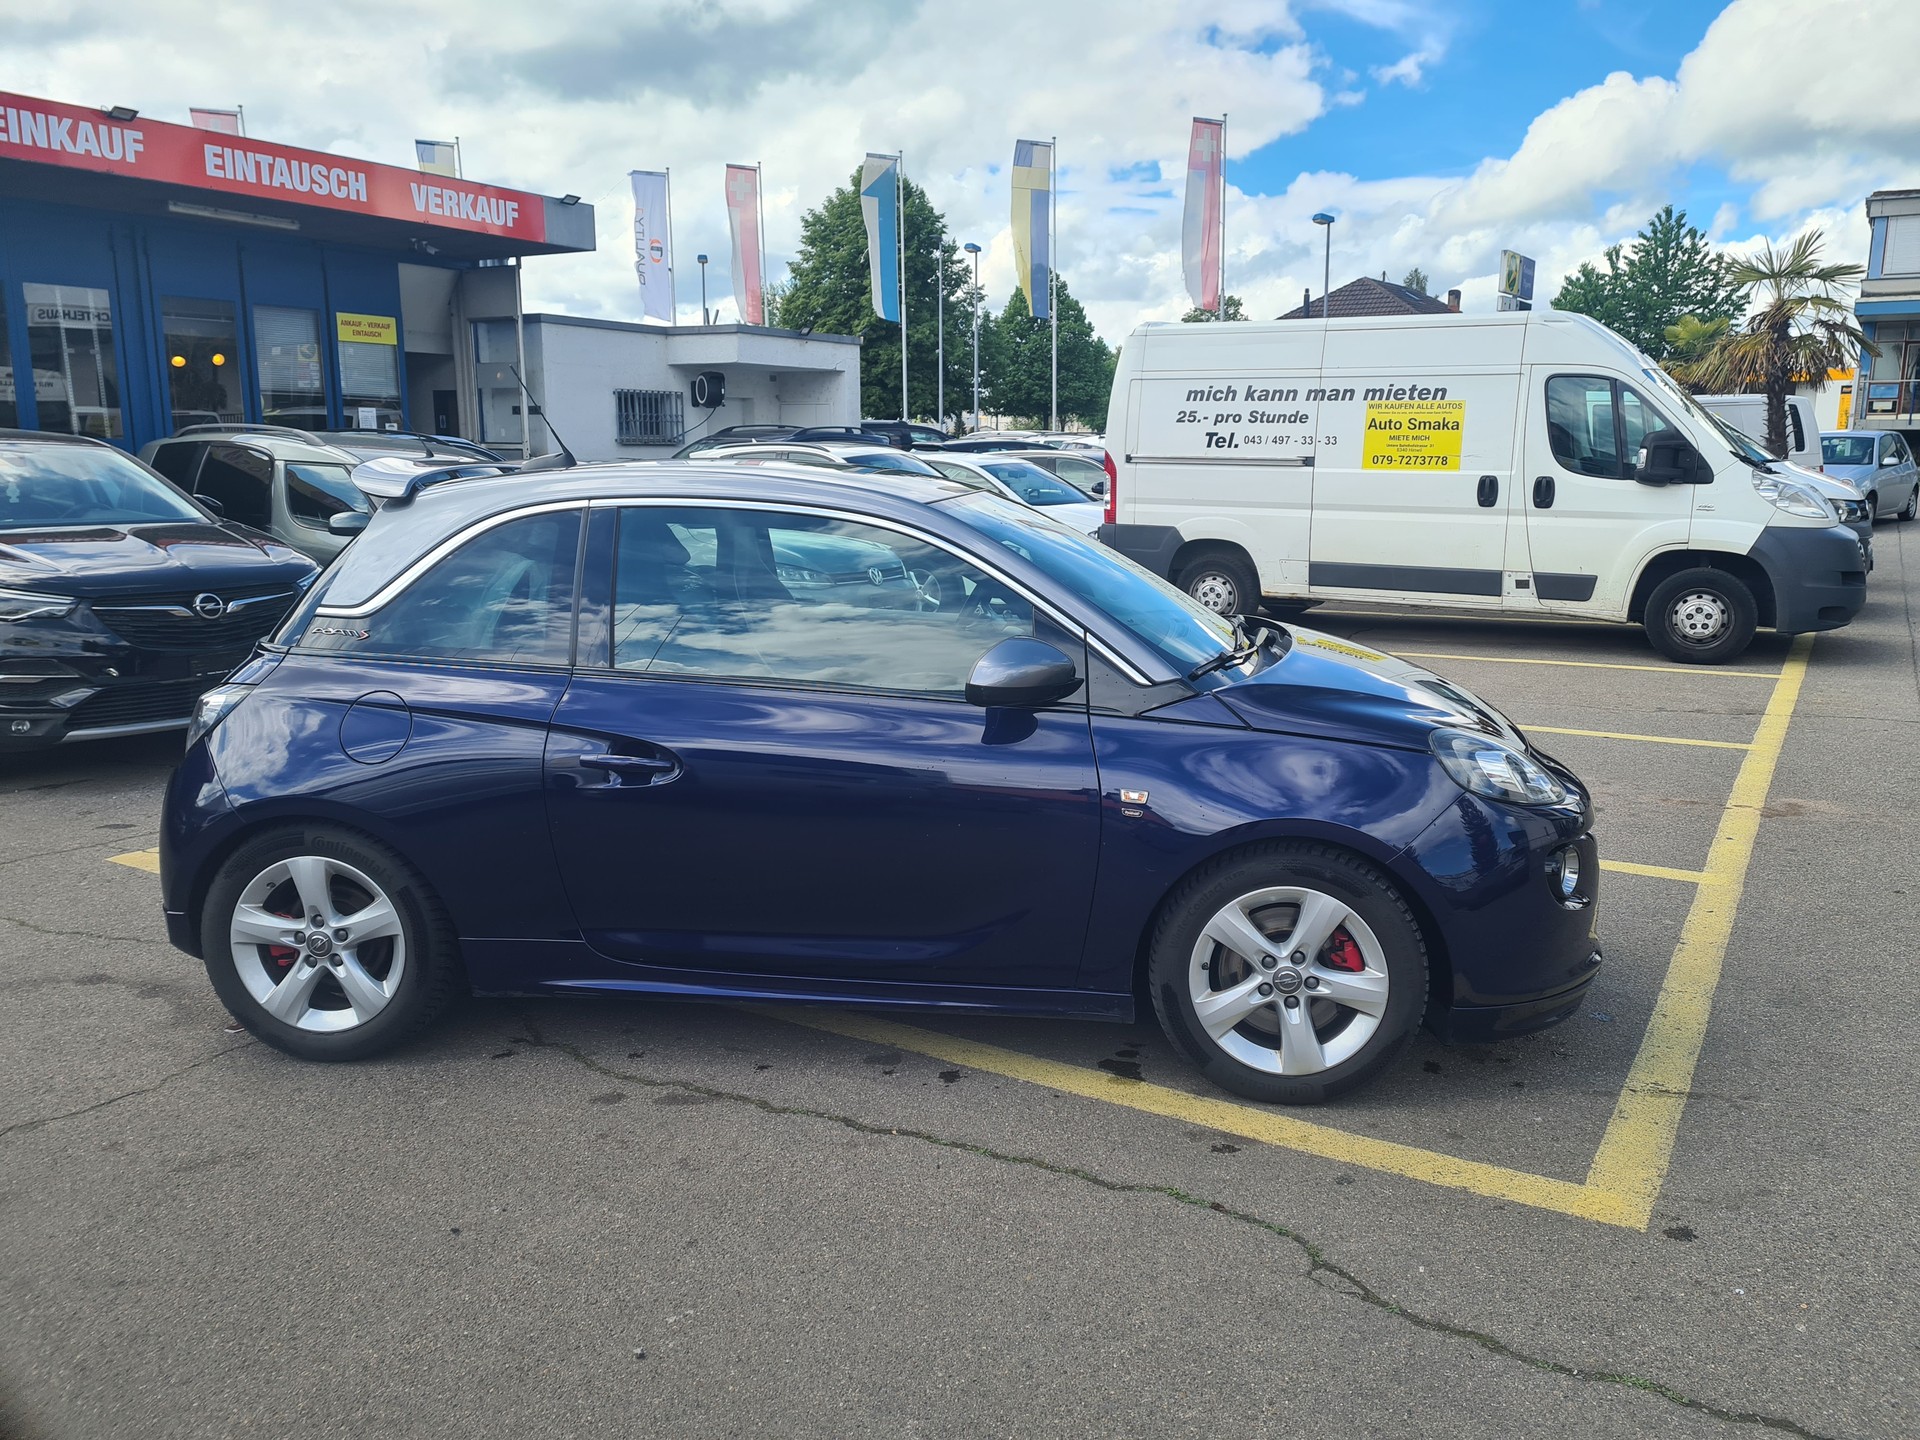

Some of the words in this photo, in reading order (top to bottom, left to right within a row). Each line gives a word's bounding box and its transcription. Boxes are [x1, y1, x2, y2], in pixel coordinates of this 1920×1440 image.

[205, 143, 367, 202] EINTAUSCH
[410, 182, 519, 227] VERKAUF
[341, 319, 362, 328] ANKAUF
[367, 321, 391, 330] VERKAUF
[353, 329, 382, 338] EINTAUSCH
[1186, 385, 1237, 402] mich
[1245, 385, 1298, 402] kann
[1305, 388, 1355, 401] man
[1363, 384, 1448, 401] mieten
[1436, 402, 1463, 410] AUTOS
[1176, 411, 1209, 424] 25.-
[1214, 413, 1242, 427] pro
[1248, 410, 1309, 425] Stunde
[1368, 417, 1403, 431] Auto
[1407, 417, 1460, 431] Smaka
[1204, 432, 1240, 449] Tel.
[1244, 436, 1262, 446] 043
[1271, 436, 1290, 446] 497
[1300, 435, 1314, 446] 33
[1325, 435, 1338, 446] 33
[1372, 455, 1448, 466] 079-7273778
